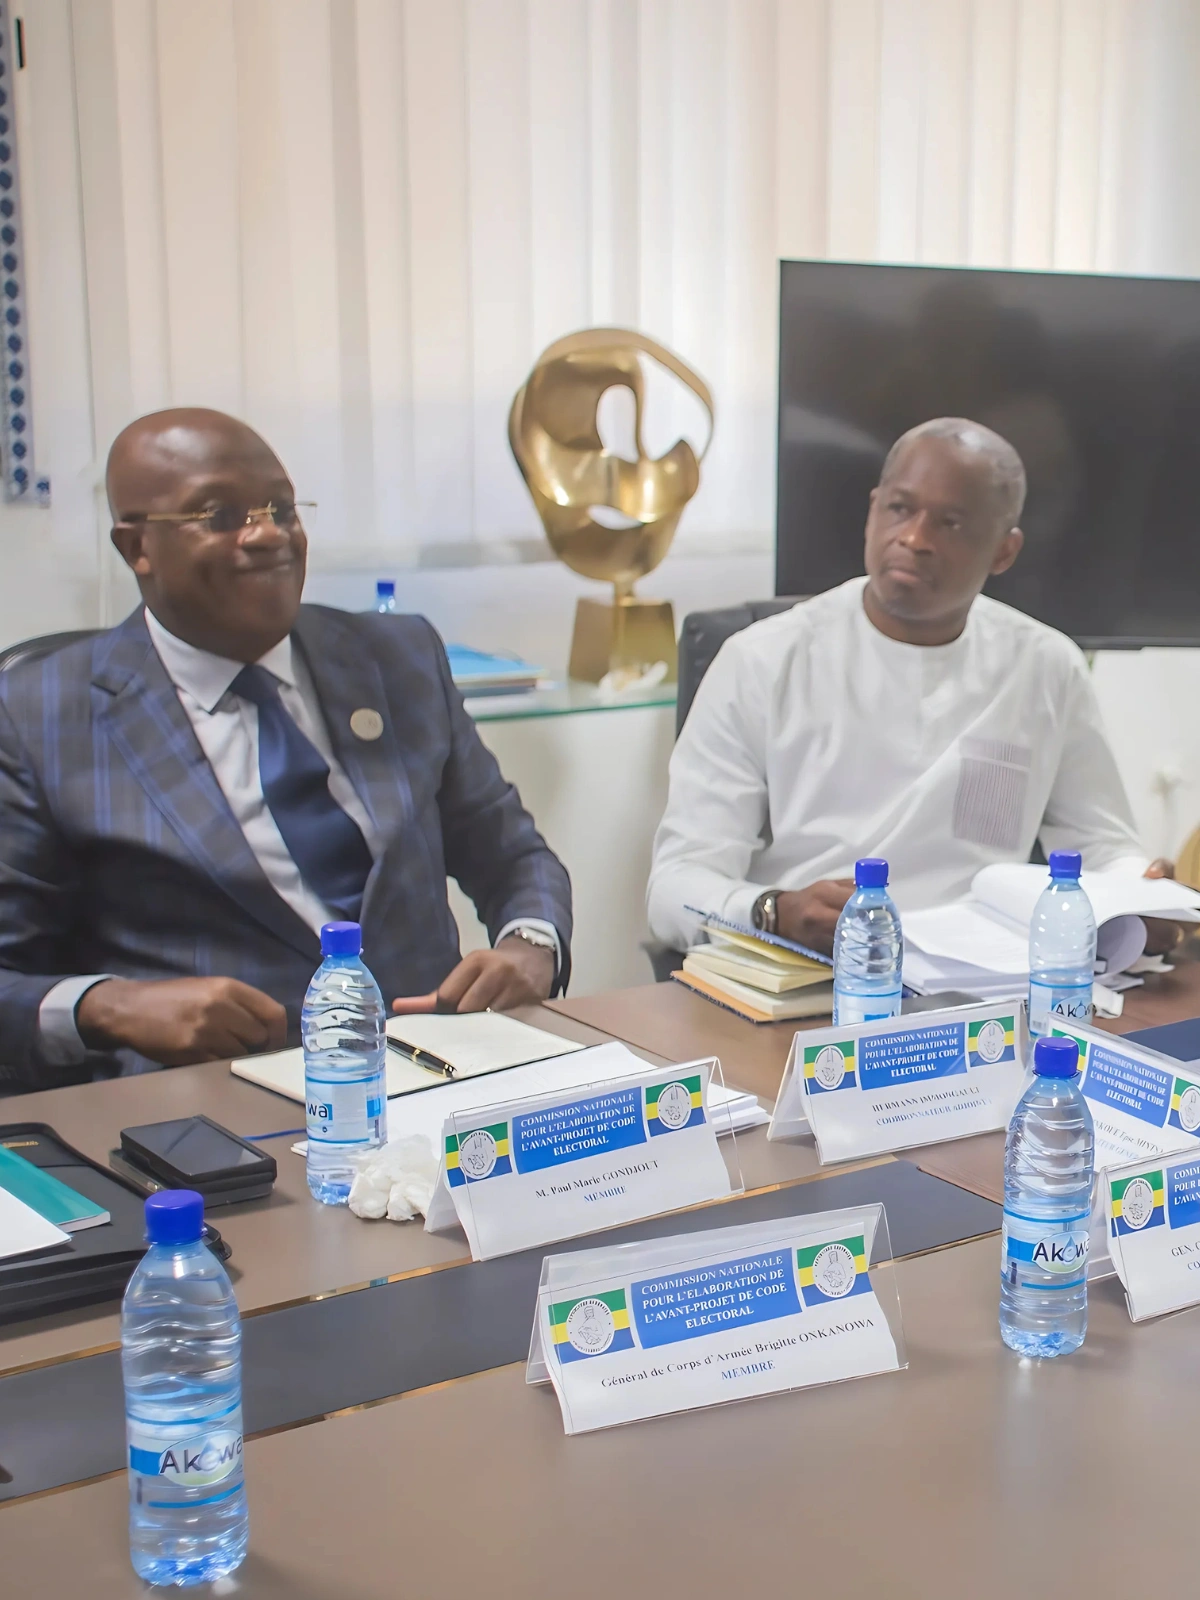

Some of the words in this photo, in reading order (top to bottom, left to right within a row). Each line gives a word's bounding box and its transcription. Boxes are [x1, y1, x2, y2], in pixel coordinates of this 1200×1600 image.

[865, 1034, 915, 1048] COMMISSION
[916, 1027, 958, 1040] NATIONALE
[865, 1049, 886, 1059] POUR
[949, 1038, 959, 1047] DE
[927, 1053, 937, 1062] DE
[938, 1048, 959, 1059] CODE
[891, 1064, 936, 1077] ELECTORAL
[1134, 1065, 1167, 1085] NATIONALE
[520, 1106, 580, 1127] COMMISSION
[583, 1092, 634, 1112] NATIONALE
[1106, 1089, 1142, 1110] ELECTORAL
[521, 1125, 546, 1140] POUR
[619, 1105, 635, 1117] DE
[597, 1122, 613, 1133] DE
[615, 1115, 636, 1129] CODE
[553, 1136, 610, 1156] ELECTORAL
[536, 1188, 549, 1199] M.
[552, 1181, 571, 1195] Paul
[574, 1176, 601, 1190] Marie
[603, 1160, 659, 1183] GONDJOUT
[1174, 1180, 1196, 1192] POUR
[584, 1185, 627, 1203] MEMBRE
[1171, 1244, 1194, 1257] GEN.
[642, 1269, 716, 1296] COMMISSION
[719, 1255, 783, 1278] NATIONALE
[643, 1293, 674, 1309] POUR
[768, 1268, 785, 1284] DE
[730, 1292, 753, 1307] DE
[755, 1282, 787, 1301] CODE
[686, 1305, 754, 1330] ELECTORAL
[601, 1369, 648, 1388] Général
[651, 1365, 664, 1376] de
[667, 1358, 702, 1375] Corps
[755, 1335, 796, 1356] Brigitte
[799, 1318, 875, 1343] ONKANOWA
[721, 1359, 776, 1380] MEMBRE
